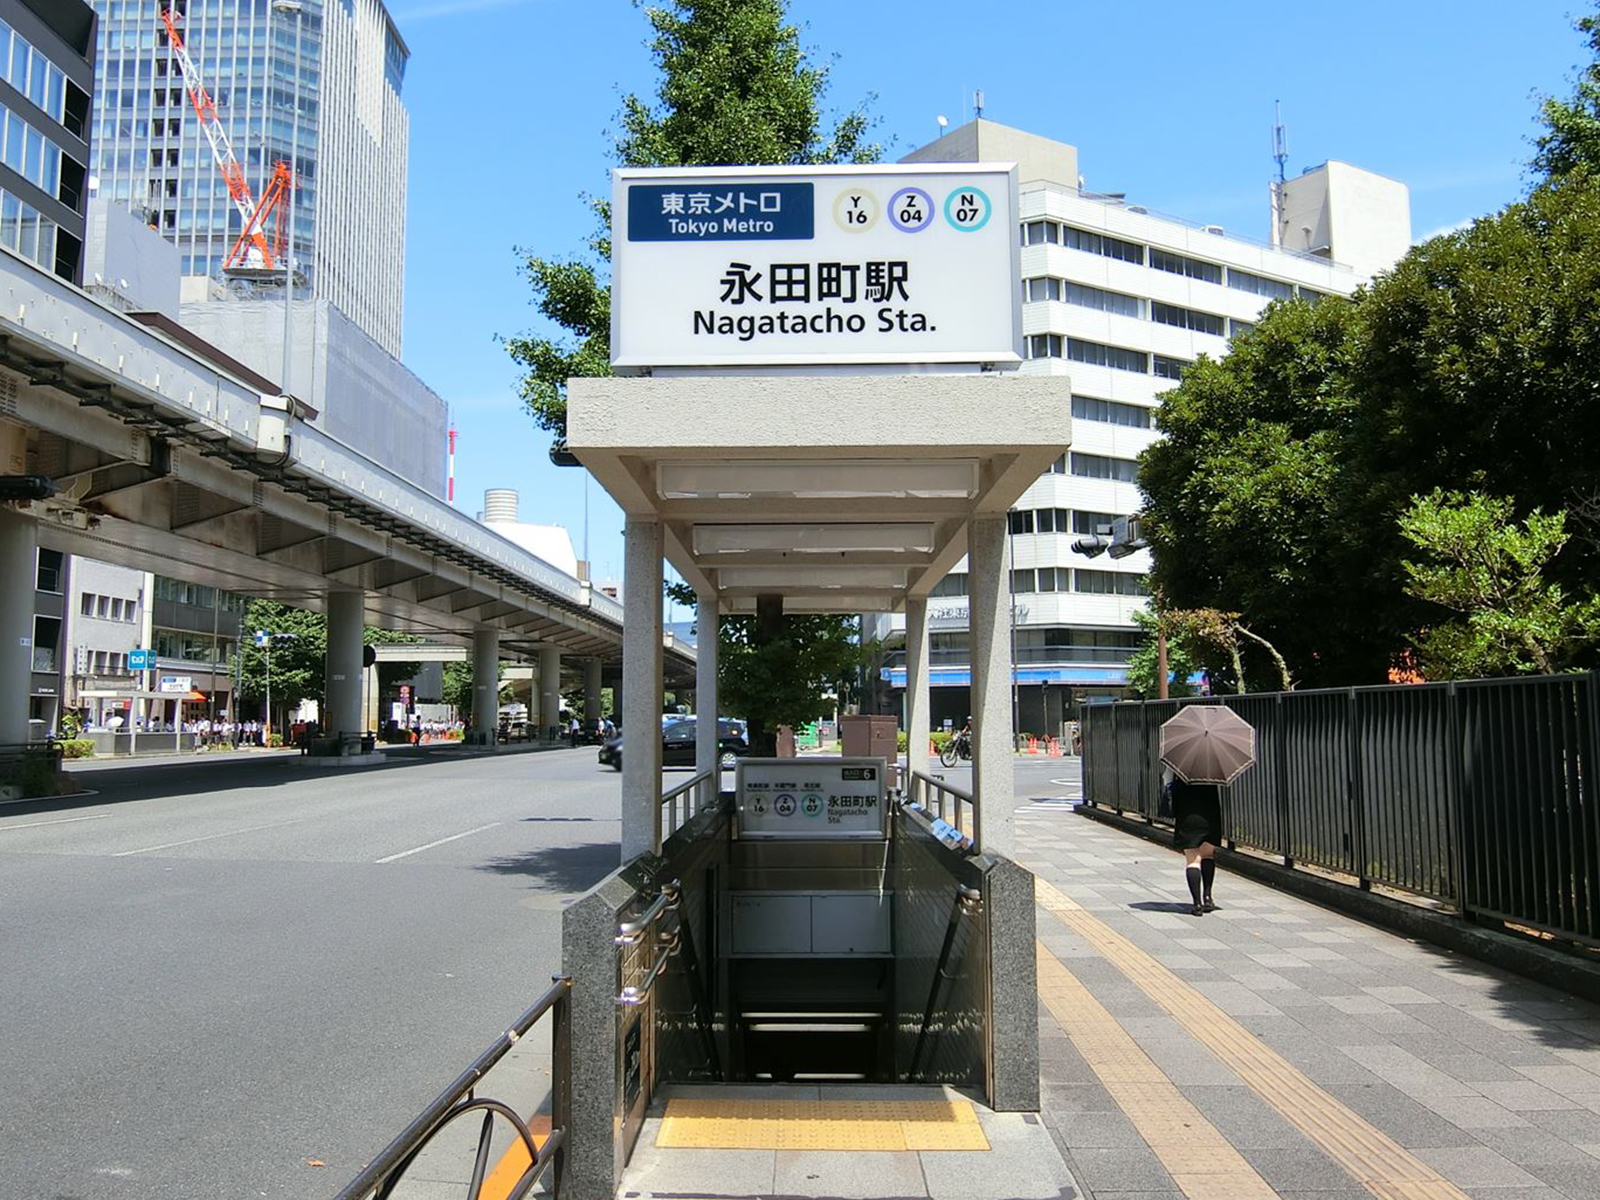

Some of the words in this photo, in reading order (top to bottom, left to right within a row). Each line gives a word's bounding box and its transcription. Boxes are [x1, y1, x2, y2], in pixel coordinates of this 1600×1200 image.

[661, 192, 781, 215] 東京メトロ
[850, 196, 861, 208] Y
[906, 195, 917, 207] Z
[961, 194, 974, 207] N
[846, 210, 868, 225] 16
[900, 209, 923, 224] 04
[956, 208, 979, 222] 07
[668, 218, 718, 237] Tokyo
[723, 218, 774, 234] Metro
[719, 260, 911, 305] 永田町駅
[693, 306, 866, 342] Nagatacho
[877, 307, 937, 334] Sta.
[863, 769, 871, 780] 6
[827, 795, 878, 808] 永田町駅
[754, 805, 765, 813] 16
[780, 805, 791, 813] 04
[806, 805, 818, 813] 07
